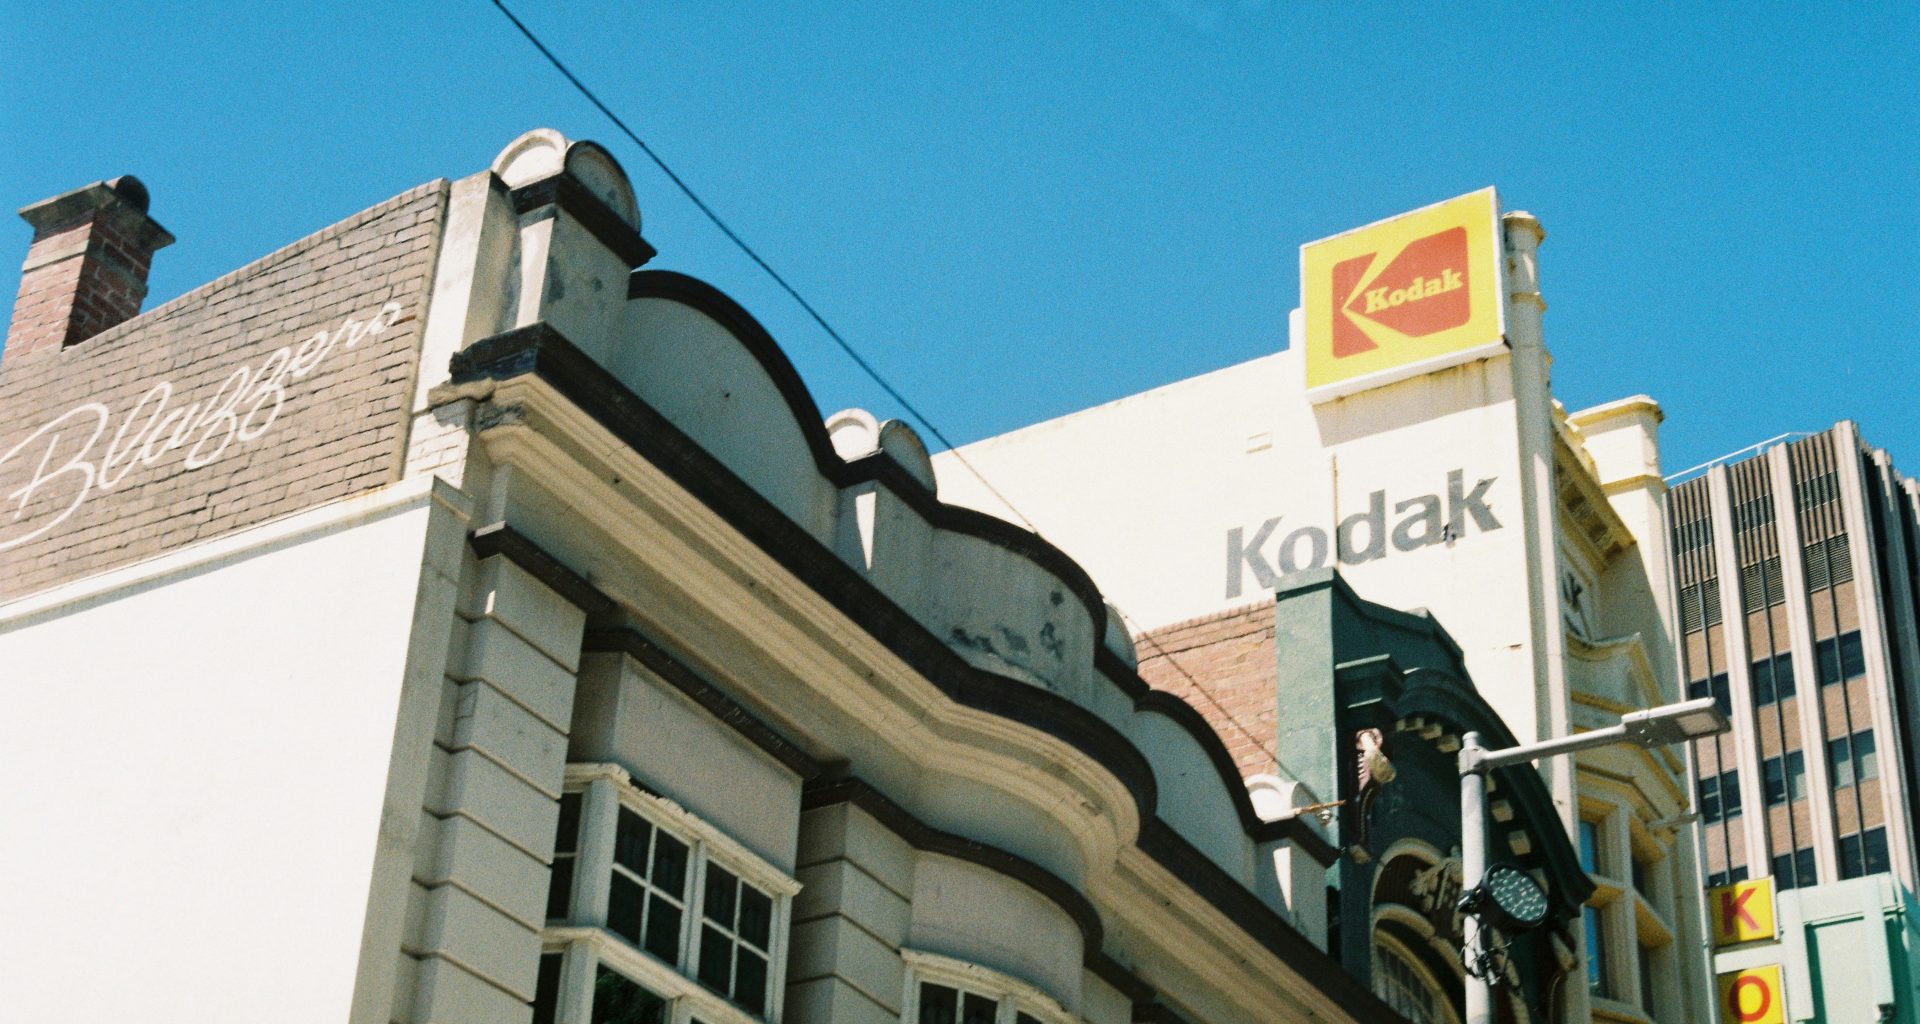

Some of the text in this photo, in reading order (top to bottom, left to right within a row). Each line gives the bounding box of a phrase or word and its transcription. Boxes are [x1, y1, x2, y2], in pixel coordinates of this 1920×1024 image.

[1364, 268, 1463, 315] Kodak
[0, 302, 401, 549] Blazzers
[1225, 469, 1503, 599] Kodak
